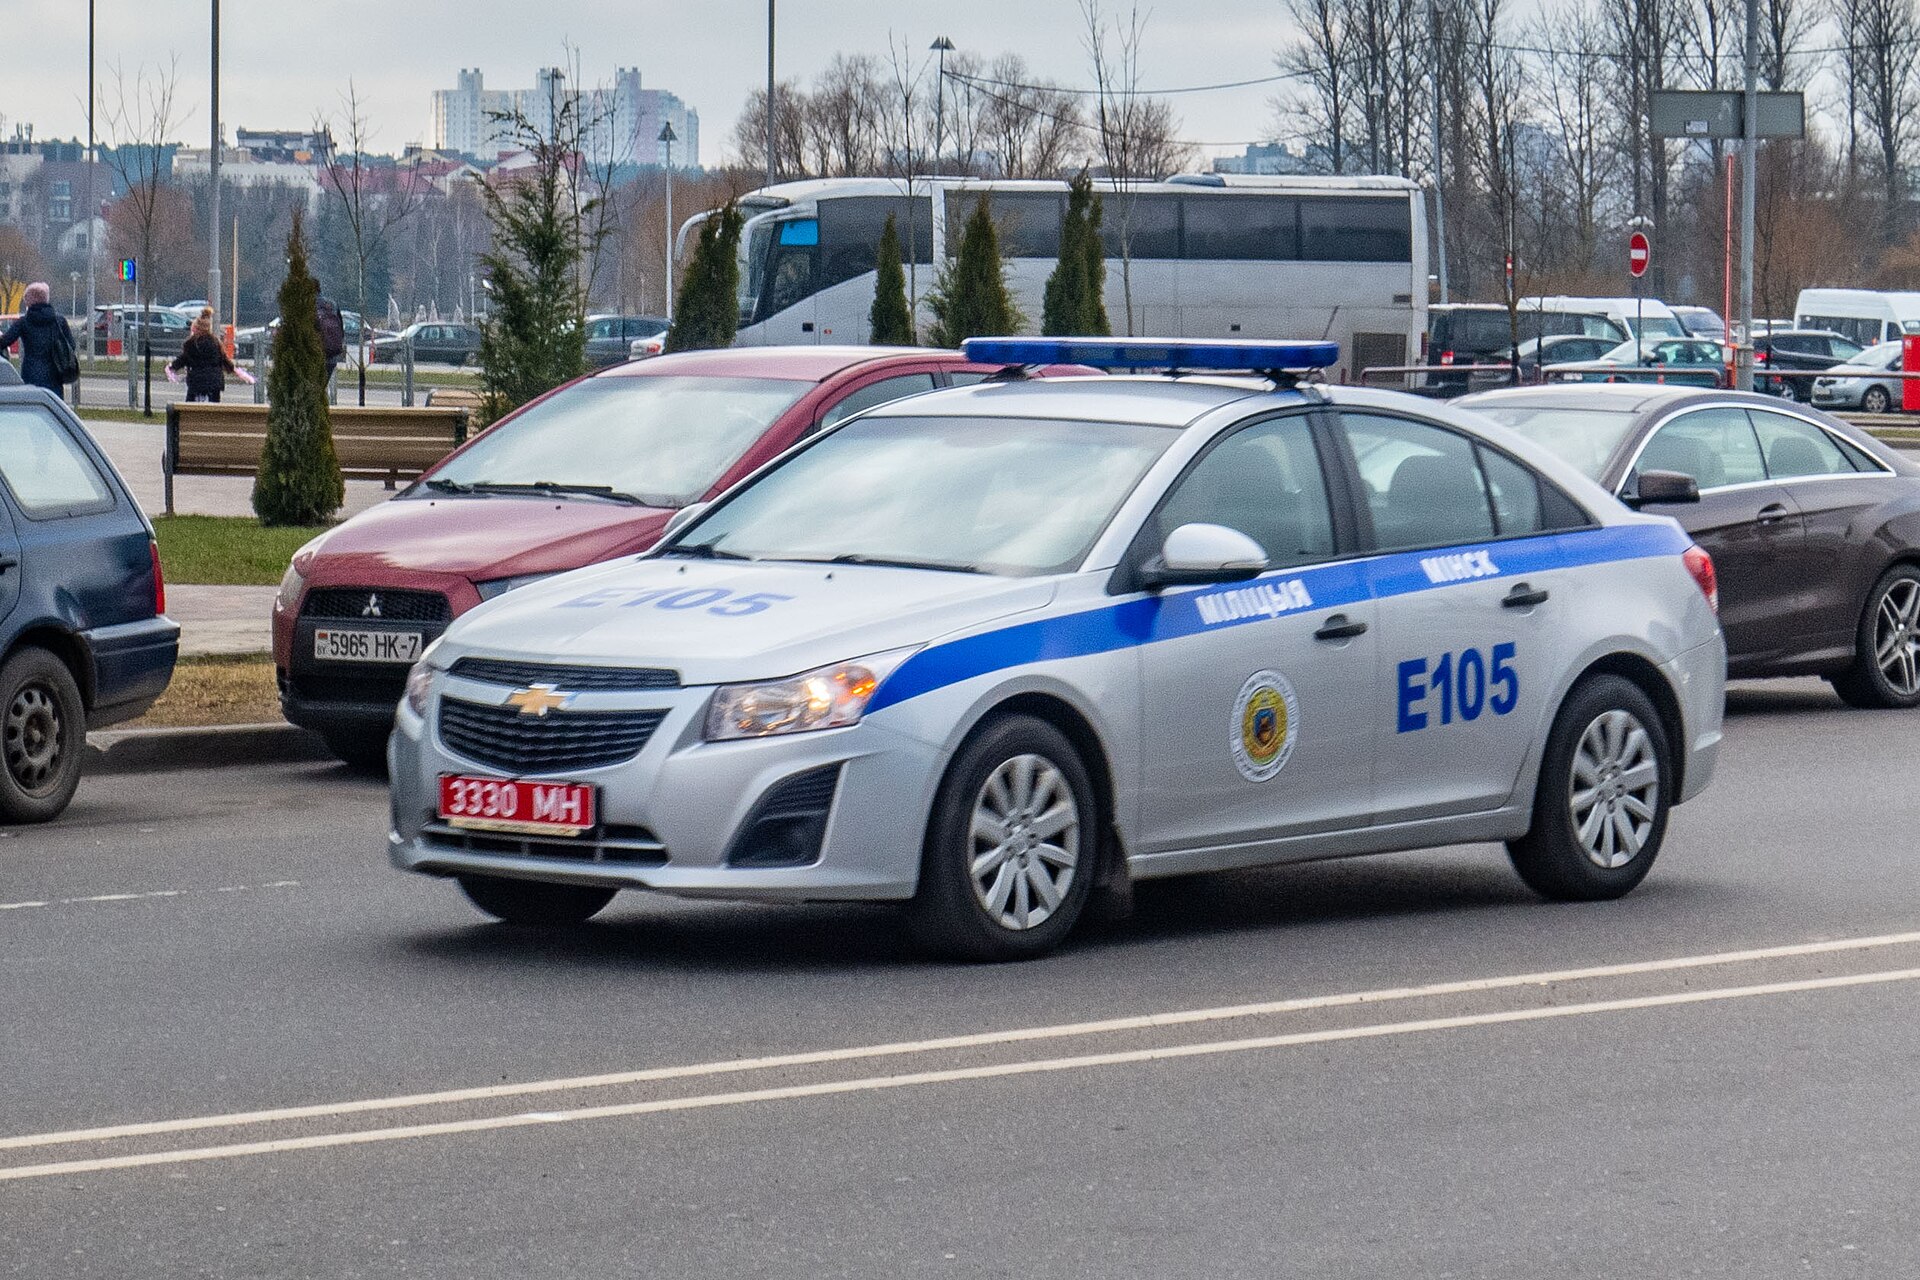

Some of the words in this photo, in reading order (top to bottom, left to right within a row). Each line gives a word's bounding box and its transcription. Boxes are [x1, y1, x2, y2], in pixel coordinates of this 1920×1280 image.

[550, 586, 798, 617] E105
[330, 633, 369, 657] 5965
[1396, 641, 1519, 734] E105
[449, 779, 519, 818] 3330
